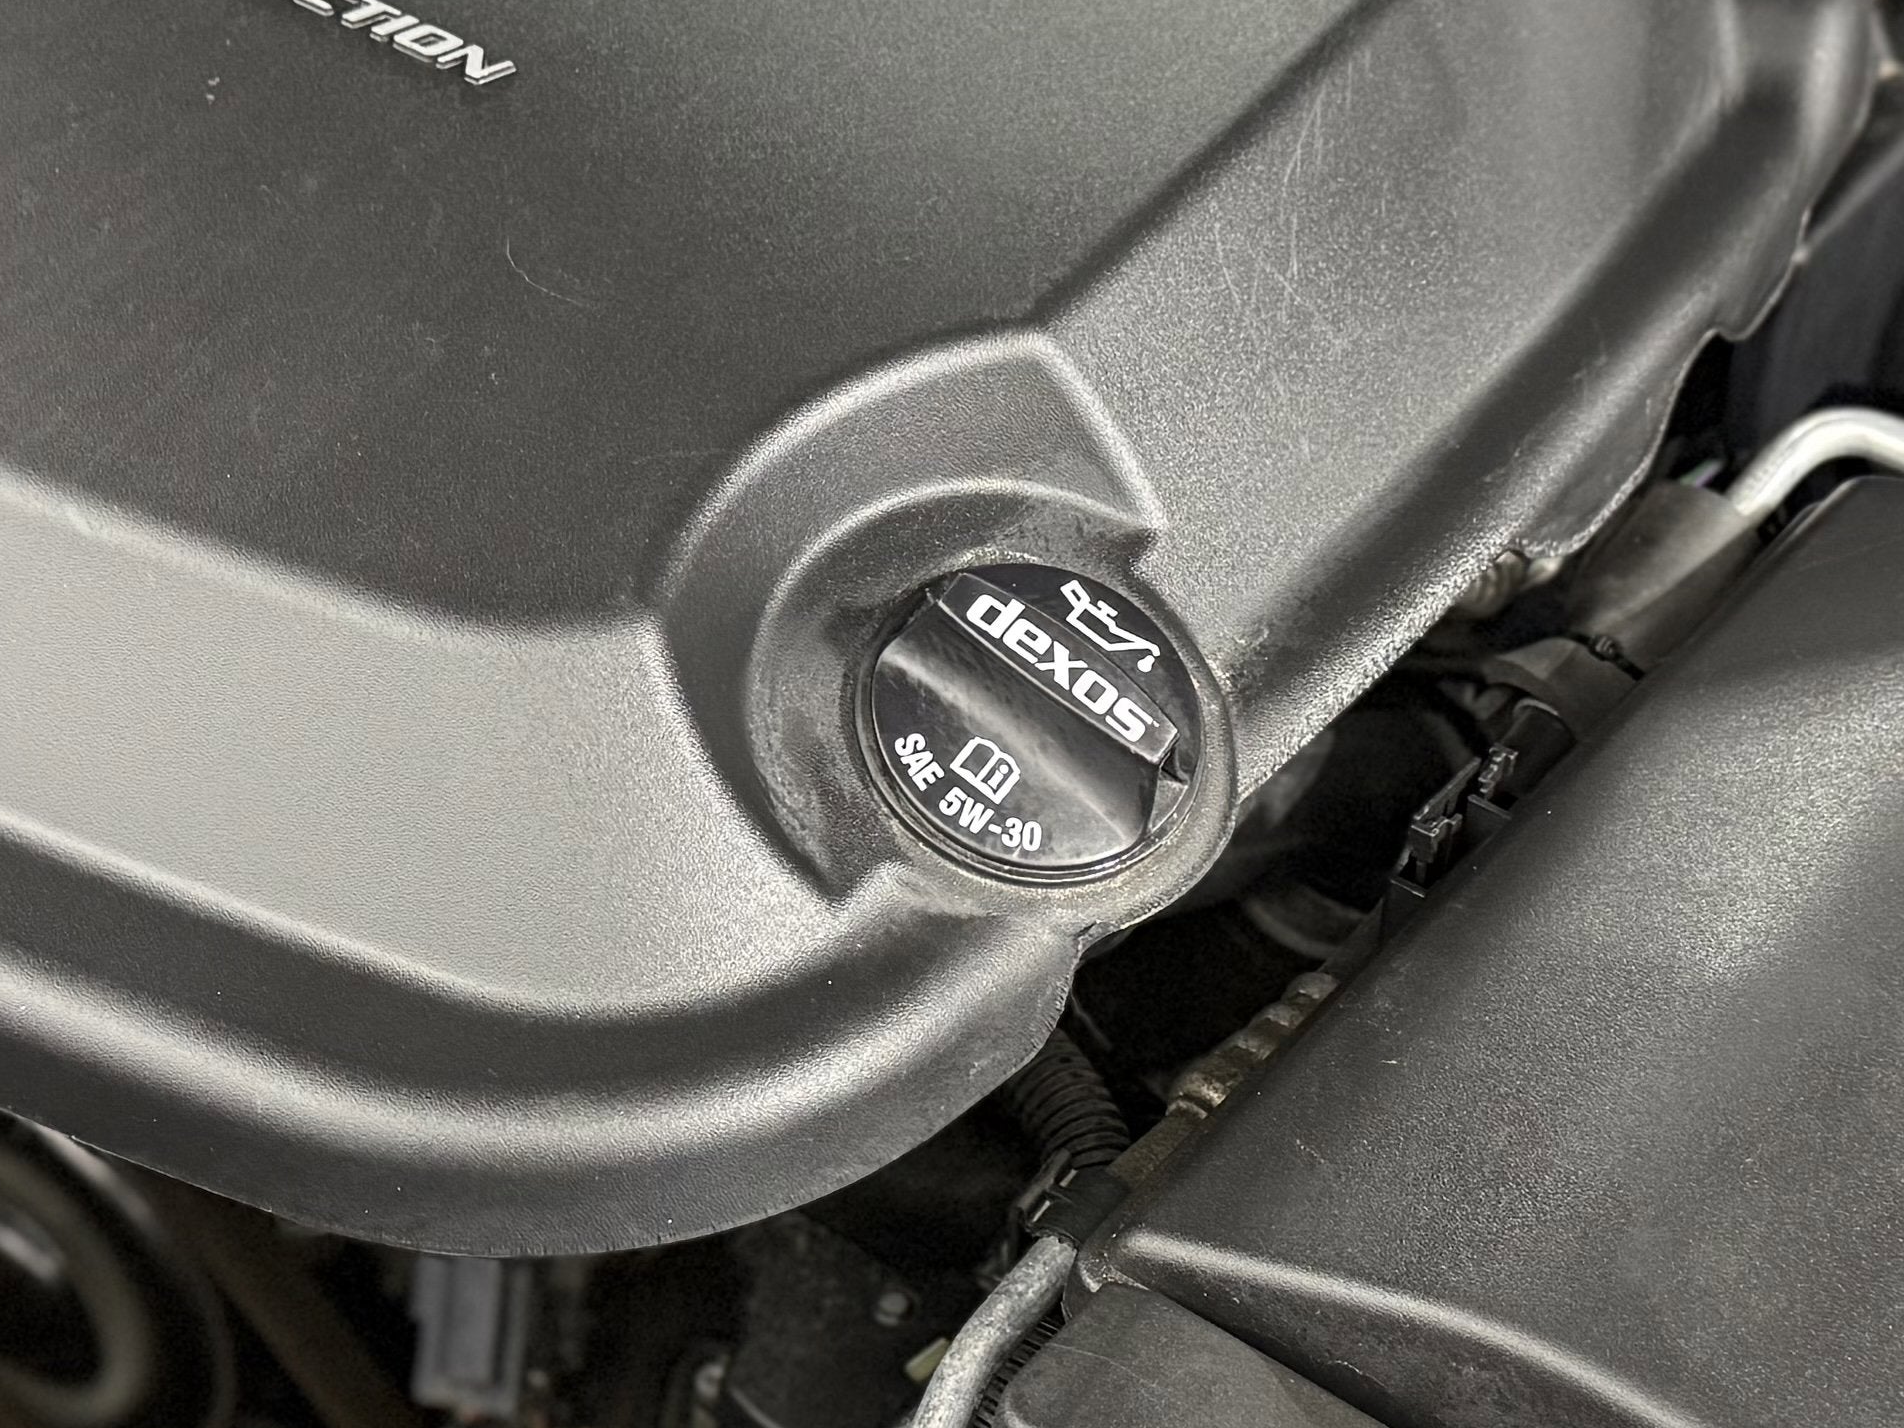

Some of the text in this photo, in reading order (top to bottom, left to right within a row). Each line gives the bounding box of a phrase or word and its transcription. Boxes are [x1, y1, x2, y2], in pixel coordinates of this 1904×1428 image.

[965, 592, 1156, 743] dexos
[893, 732, 1044, 853] SAE 5W-30
